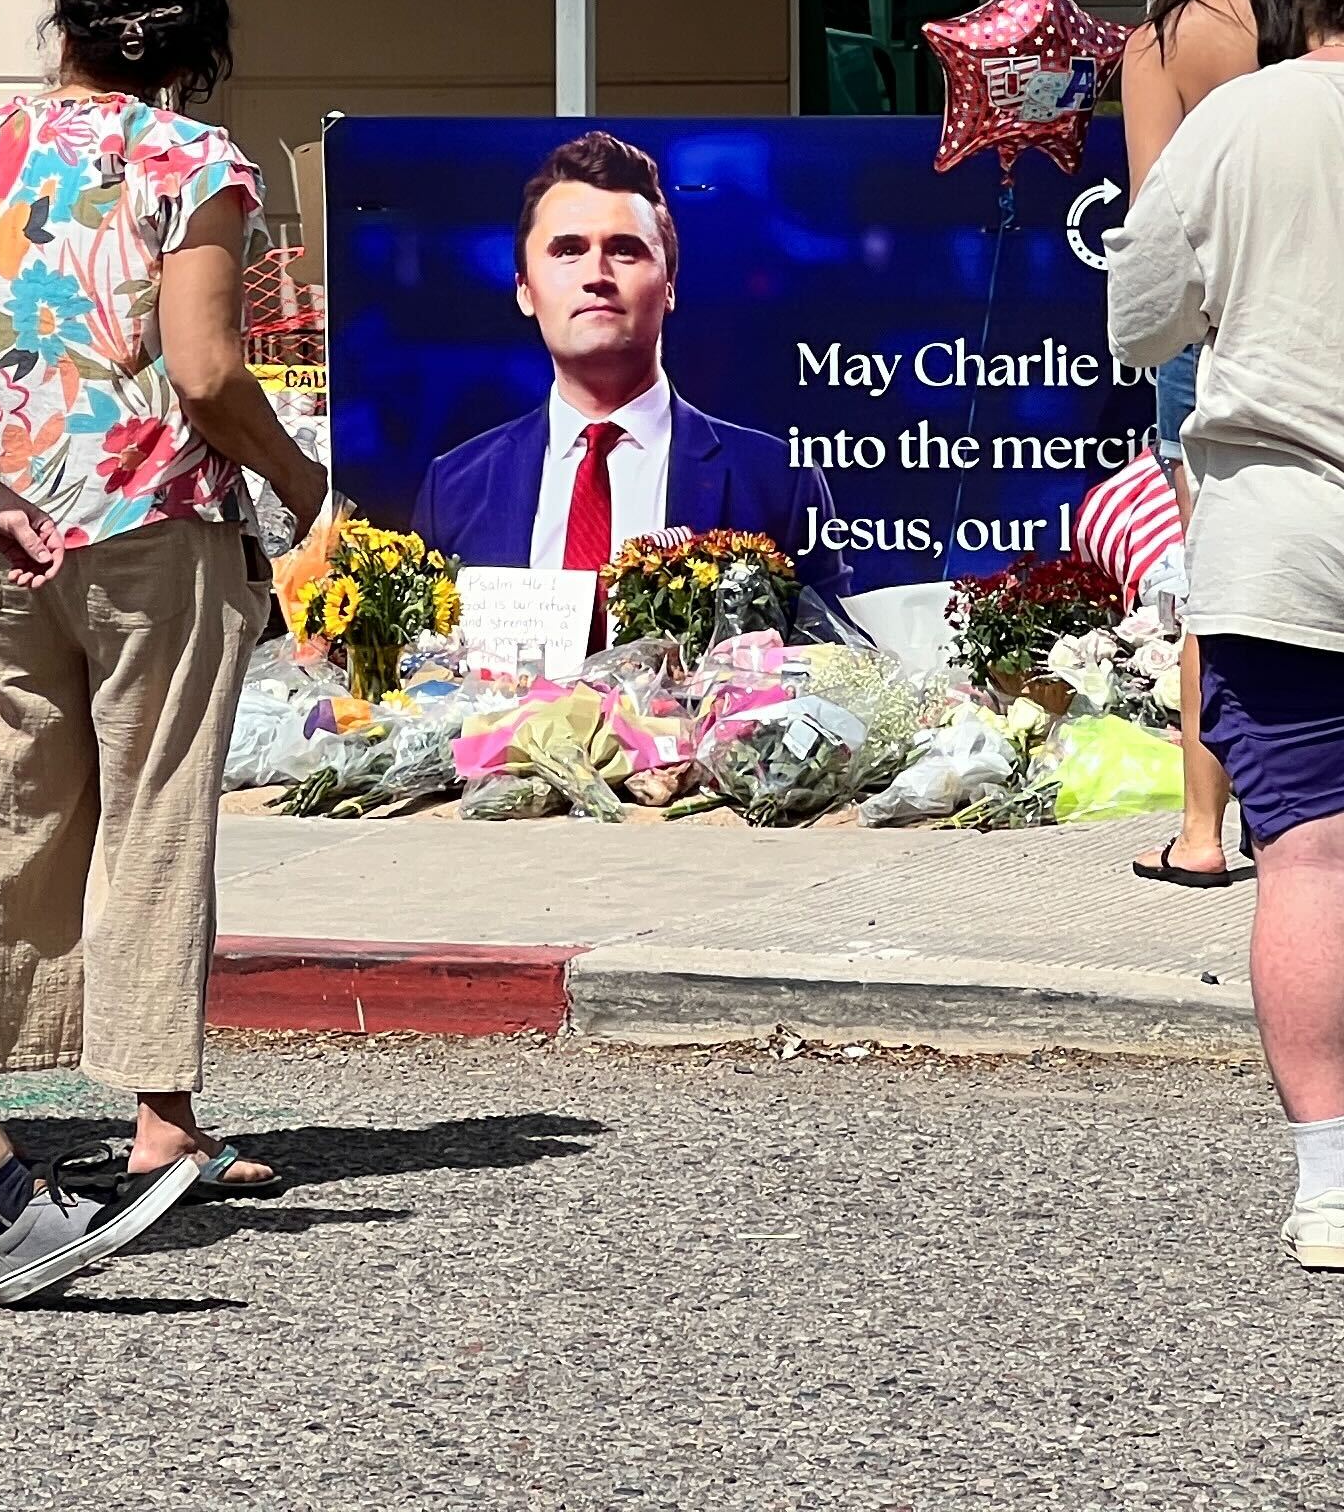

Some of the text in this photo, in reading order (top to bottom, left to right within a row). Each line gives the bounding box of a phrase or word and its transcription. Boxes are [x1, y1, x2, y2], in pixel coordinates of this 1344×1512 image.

[796, 337, 1157, 397] May Charlie b
[788, 426, 886, 469] into
[897, 419, 980, 469] the
[797, 506, 944, 559] Jesus,
[956, 518, 1047, 552] our
[468, 575, 513, 591] Psalm
